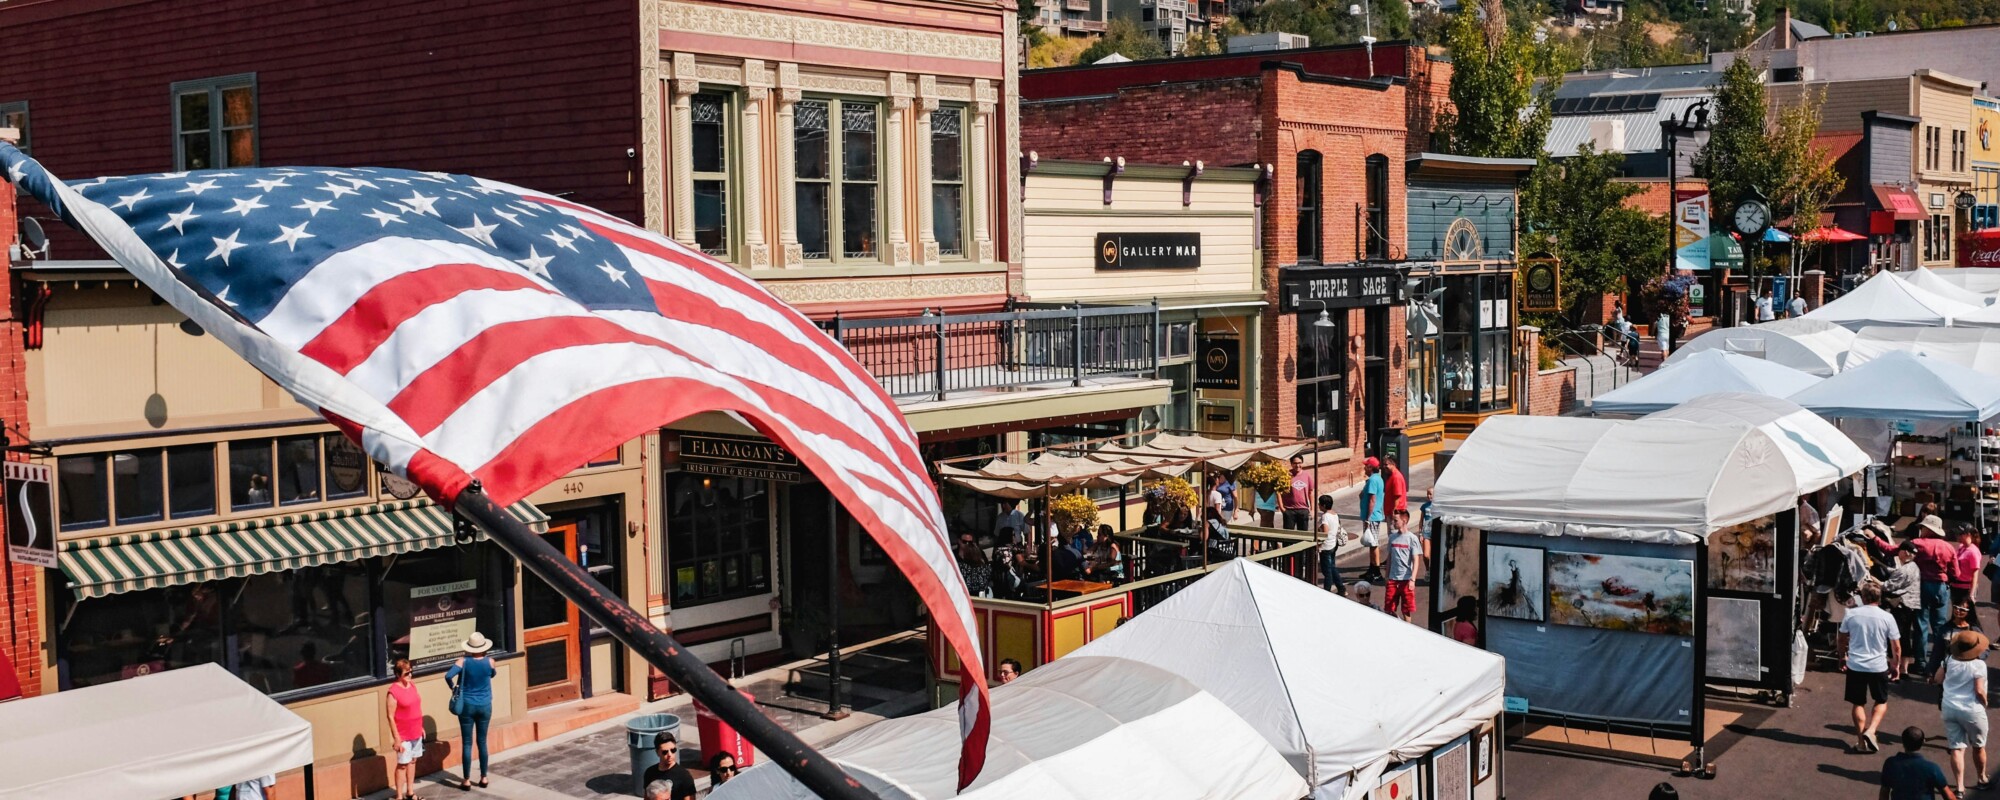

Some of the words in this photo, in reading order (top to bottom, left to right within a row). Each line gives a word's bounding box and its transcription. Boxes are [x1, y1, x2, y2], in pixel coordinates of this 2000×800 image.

[1956, 197, 1975, 205] ROOTS
[1122, 246, 1172, 257] GALLERY
[1175, 245, 1197, 256] MAR
[1309, 278, 1349, 299] PURPLE
[1362, 276, 1388, 296] SAGE
[692, 440, 785, 460] FLANAGAN'S
[686, 463, 709, 472] IRISH
[711, 466, 727, 474] PUB
[737, 468, 792, 481] RESTAURANT
[563, 481, 584, 494] 440
[432, 585, 447, 593] SALE
[452, 581, 470, 590] LEASE
[414, 613, 445, 621] BERKSHIRE
[446, 607, 473, 617] HATHAWAY
